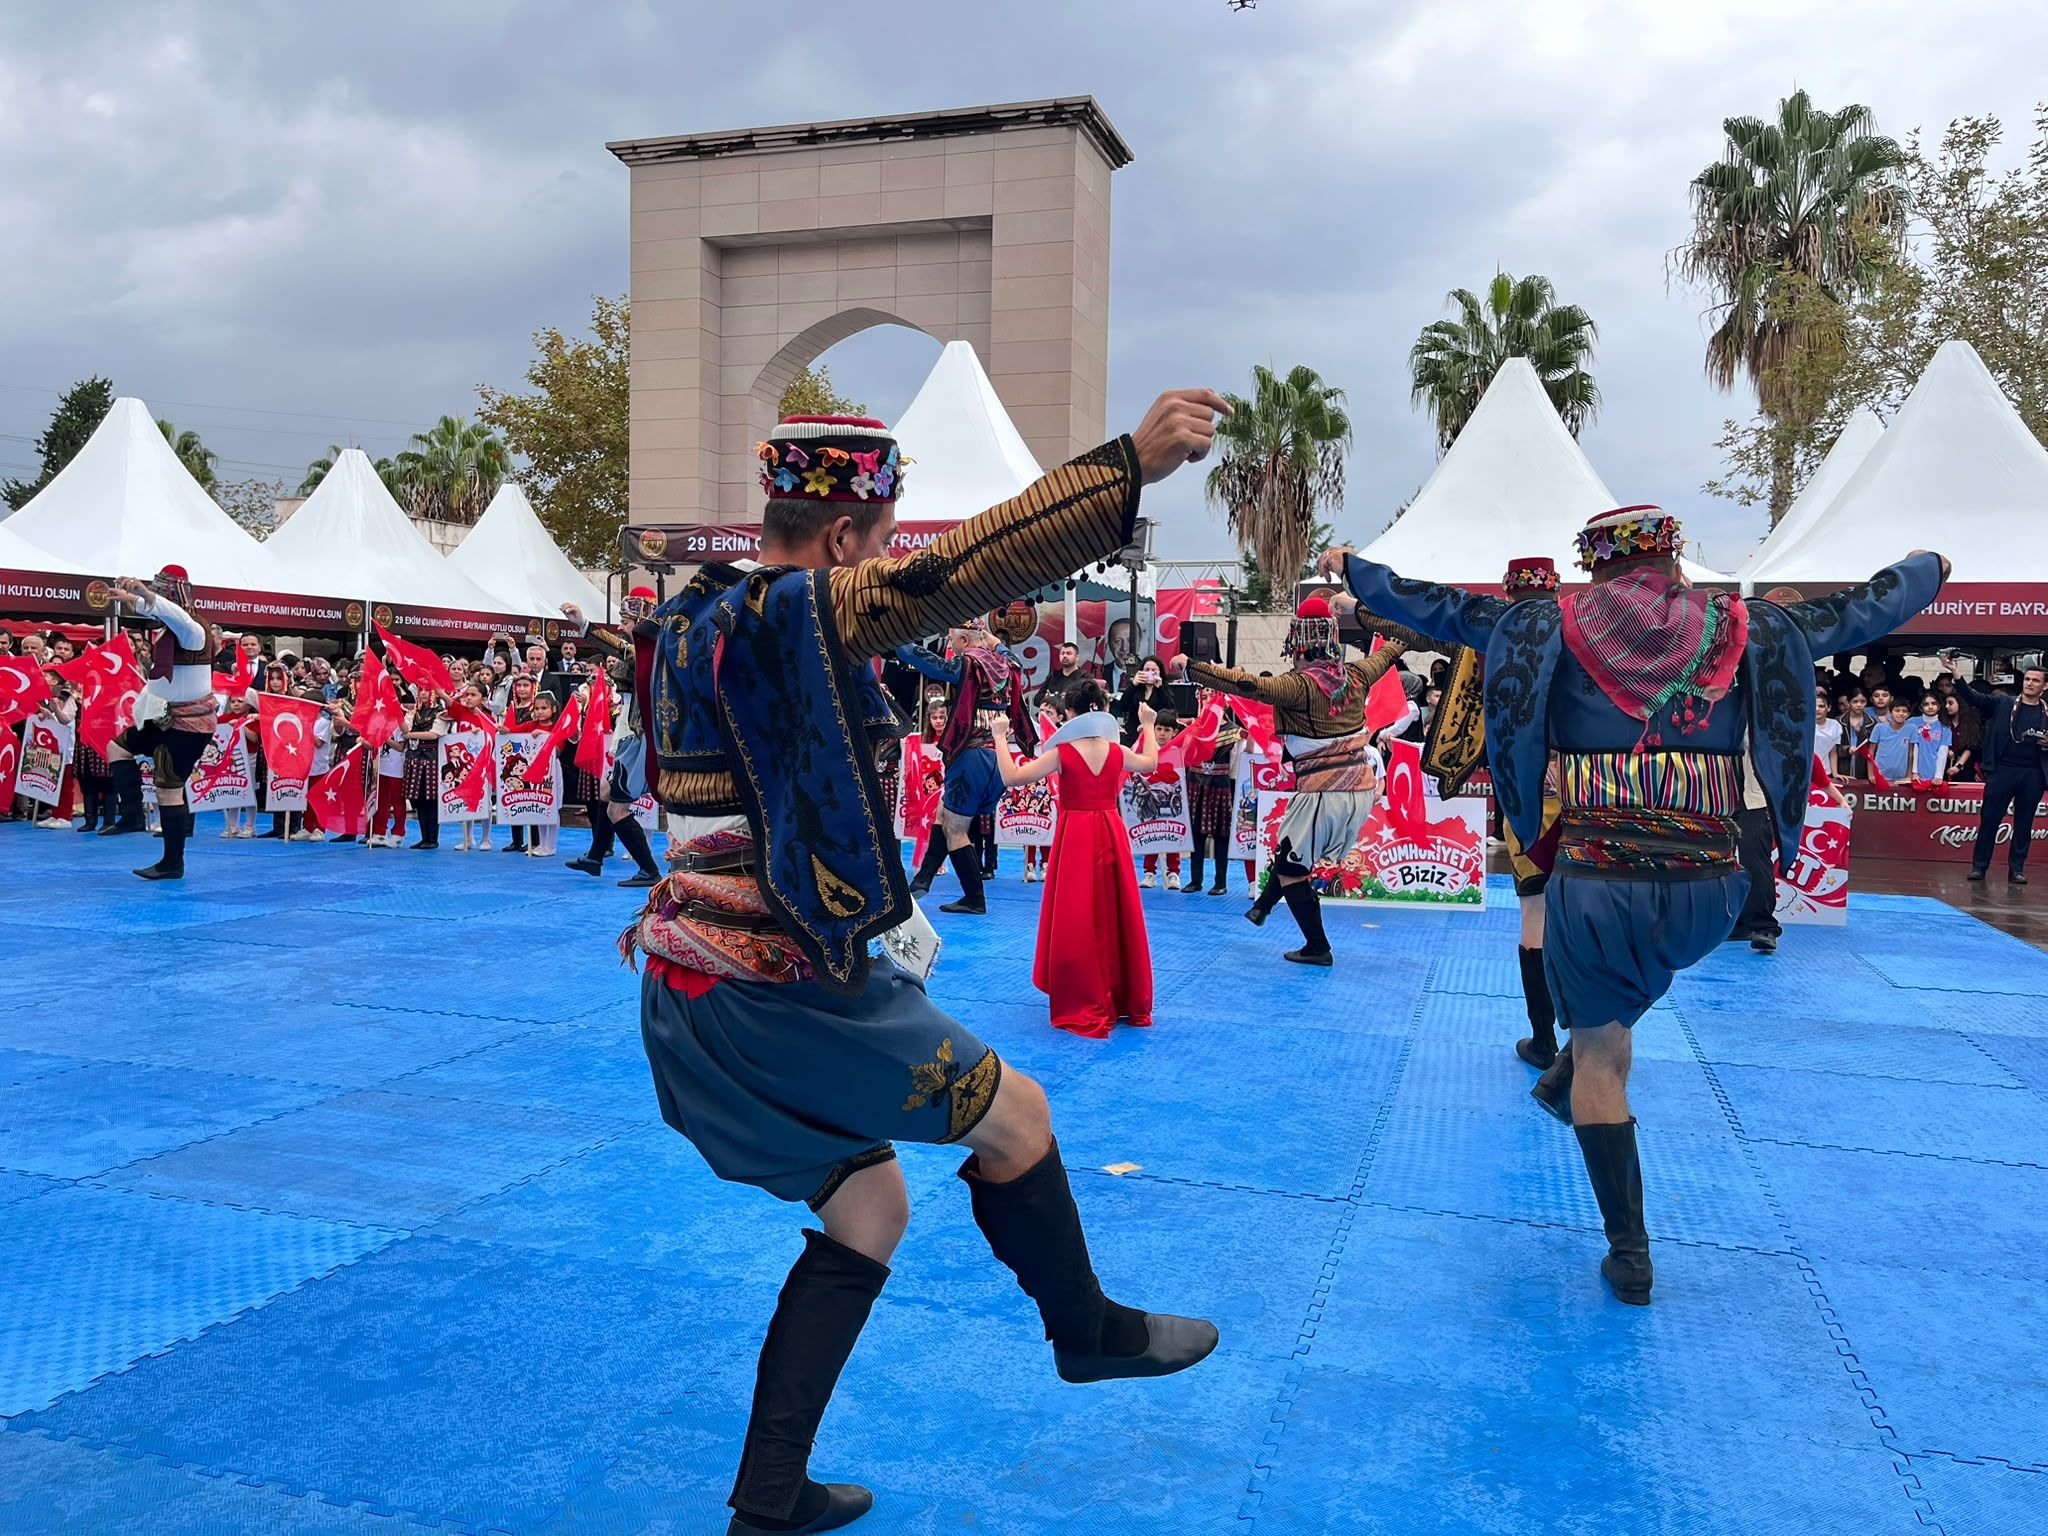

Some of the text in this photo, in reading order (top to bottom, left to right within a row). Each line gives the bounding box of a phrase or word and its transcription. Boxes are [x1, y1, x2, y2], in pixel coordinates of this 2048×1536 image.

[687, 536, 706, 551] 29
[711, 533, 750, 551] EKİM
[887, 533, 942, 548] YRAM
[7, 584, 43, 598] KUTLU
[45, 587, 81, 600] OLSUN
[194, 598, 342, 619] CUMHURİYET BAYRAMI KUTLU OLSUN
[1920, 600, 1997, 615] HURİYET
[394, 615, 404, 624] 29
[404, 616, 421, 626] EKİM
[421, 617, 463, 629] CUMHURİYET
[507, 624, 526, 633] OLSUN
[504, 791, 552, 804] CUMHURİYET
[1843, 793, 1857, 809] 9
[1863, 793, 1916, 812] EKİM
[1130, 821, 1185, 837] CUMHURİYET
[1930, 824, 1978, 848] Kutl
[1379, 838, 1470, 870] CUMHURİYET
[1399, 865, 1448, 887] Biziz
